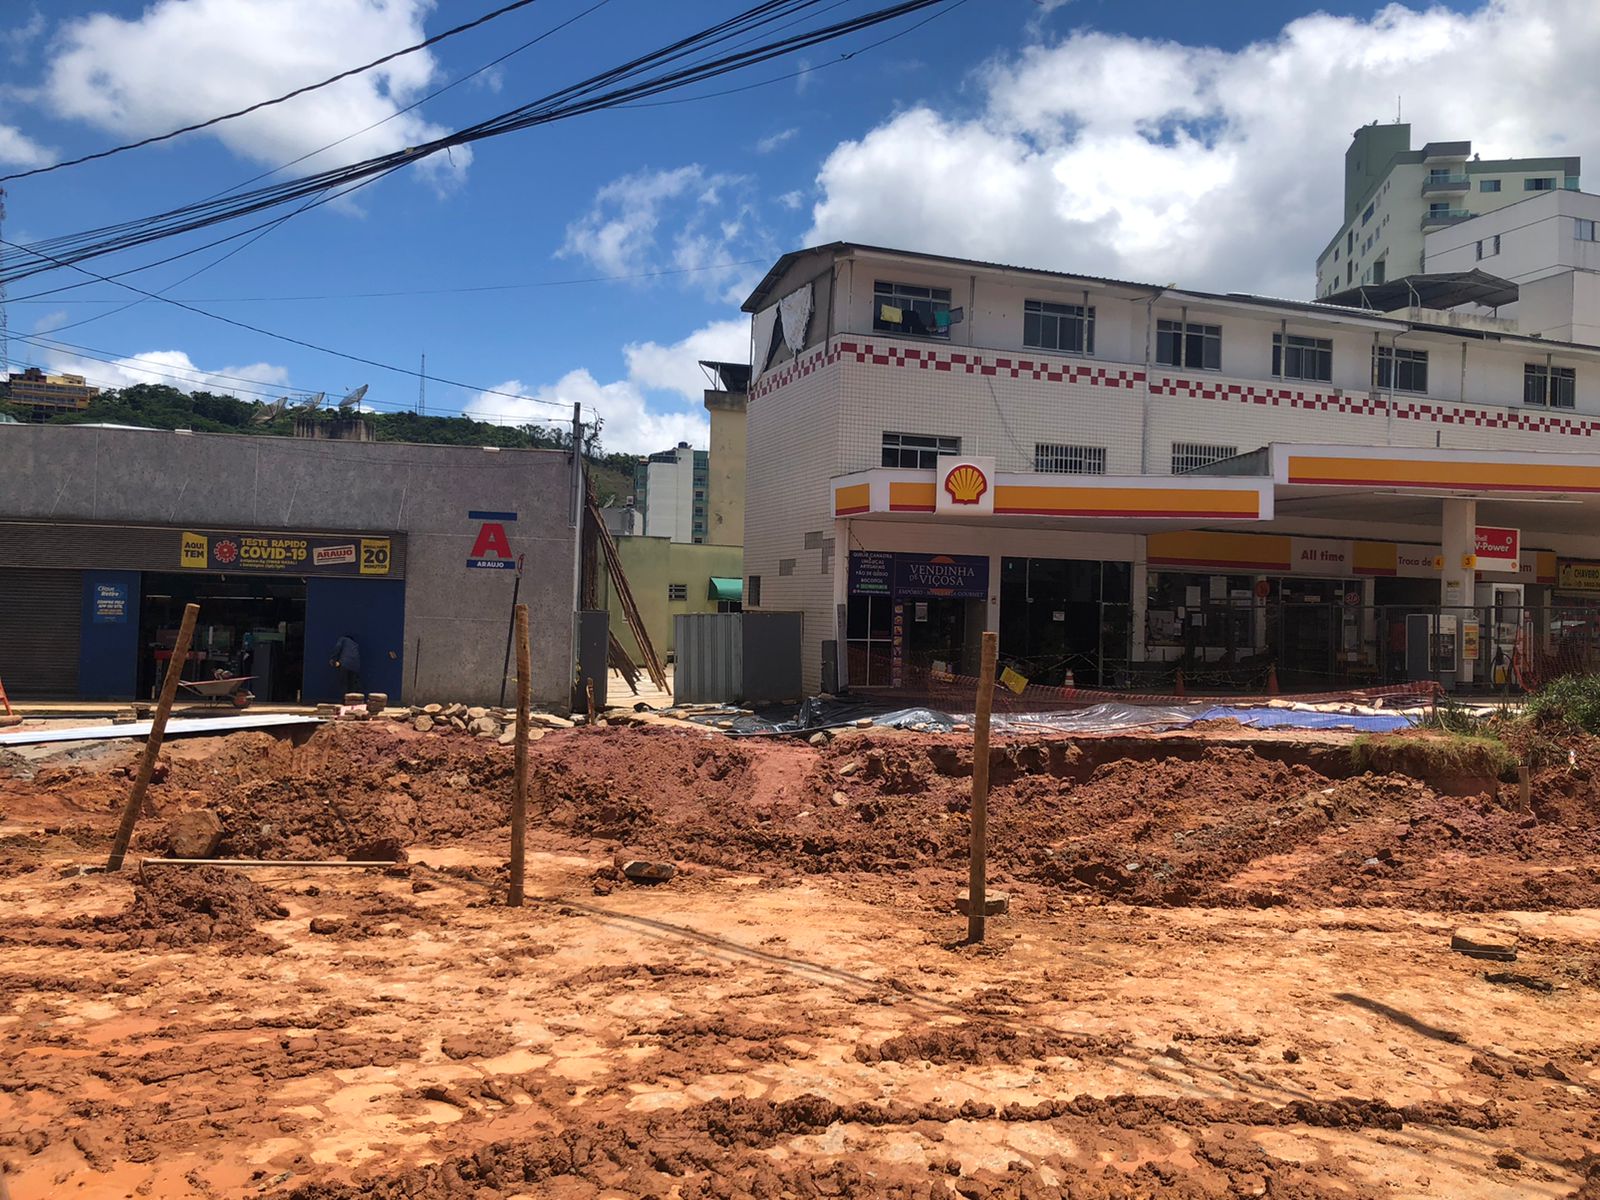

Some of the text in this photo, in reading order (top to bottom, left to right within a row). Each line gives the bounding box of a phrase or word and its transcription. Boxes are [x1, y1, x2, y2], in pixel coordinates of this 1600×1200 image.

[184, 541, 205, 550] AQUI
[240, 538, 269, 546] TESTE
[470, 522, 513, 558] A
[183, 549, 205, 559] TEM
[240, 546, 308, 560] COVID-19
[317, 549, 352, 558] ARAUJO
[363, 549, 388, 564] 20
[1300, 549, 1344, 561] All time
[1398, 556, 1420, 566] Troca
[910, 564, 975, 577] VENDINHA
[919, 575, 965, 587] VIÇOSA
